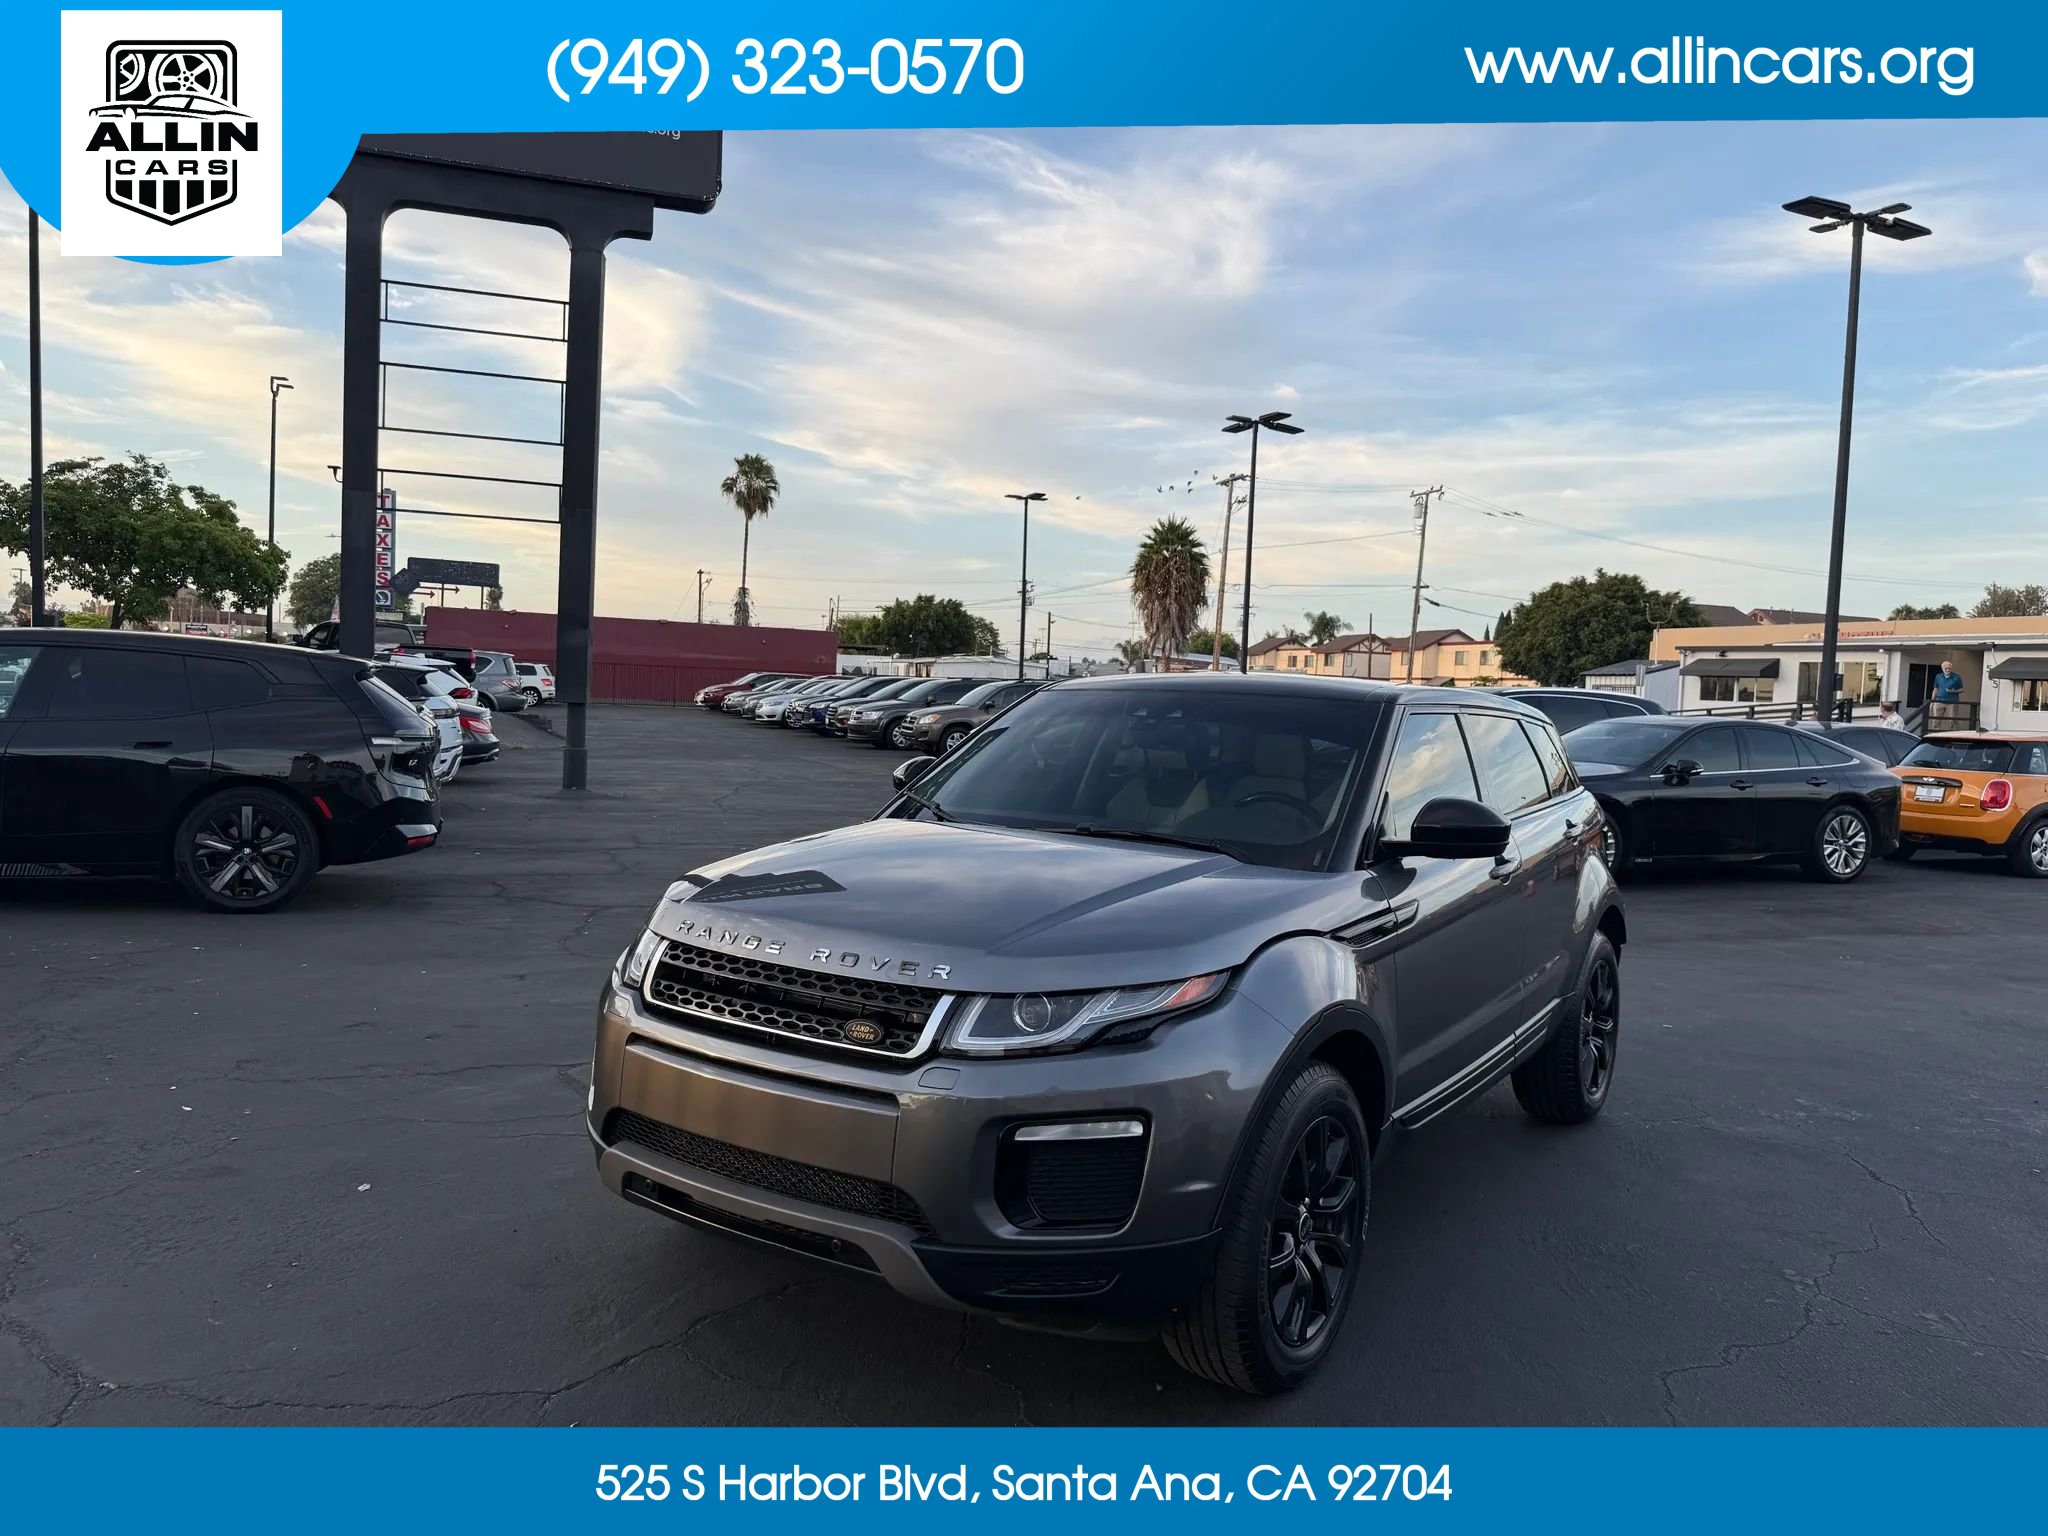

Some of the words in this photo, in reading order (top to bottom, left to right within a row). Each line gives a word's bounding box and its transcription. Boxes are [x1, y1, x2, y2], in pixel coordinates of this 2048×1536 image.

[376, 495, 389, 586] TAXES
[676, 919, 786, 955] RANGE
[809, 948, 952, 980] ROVER
